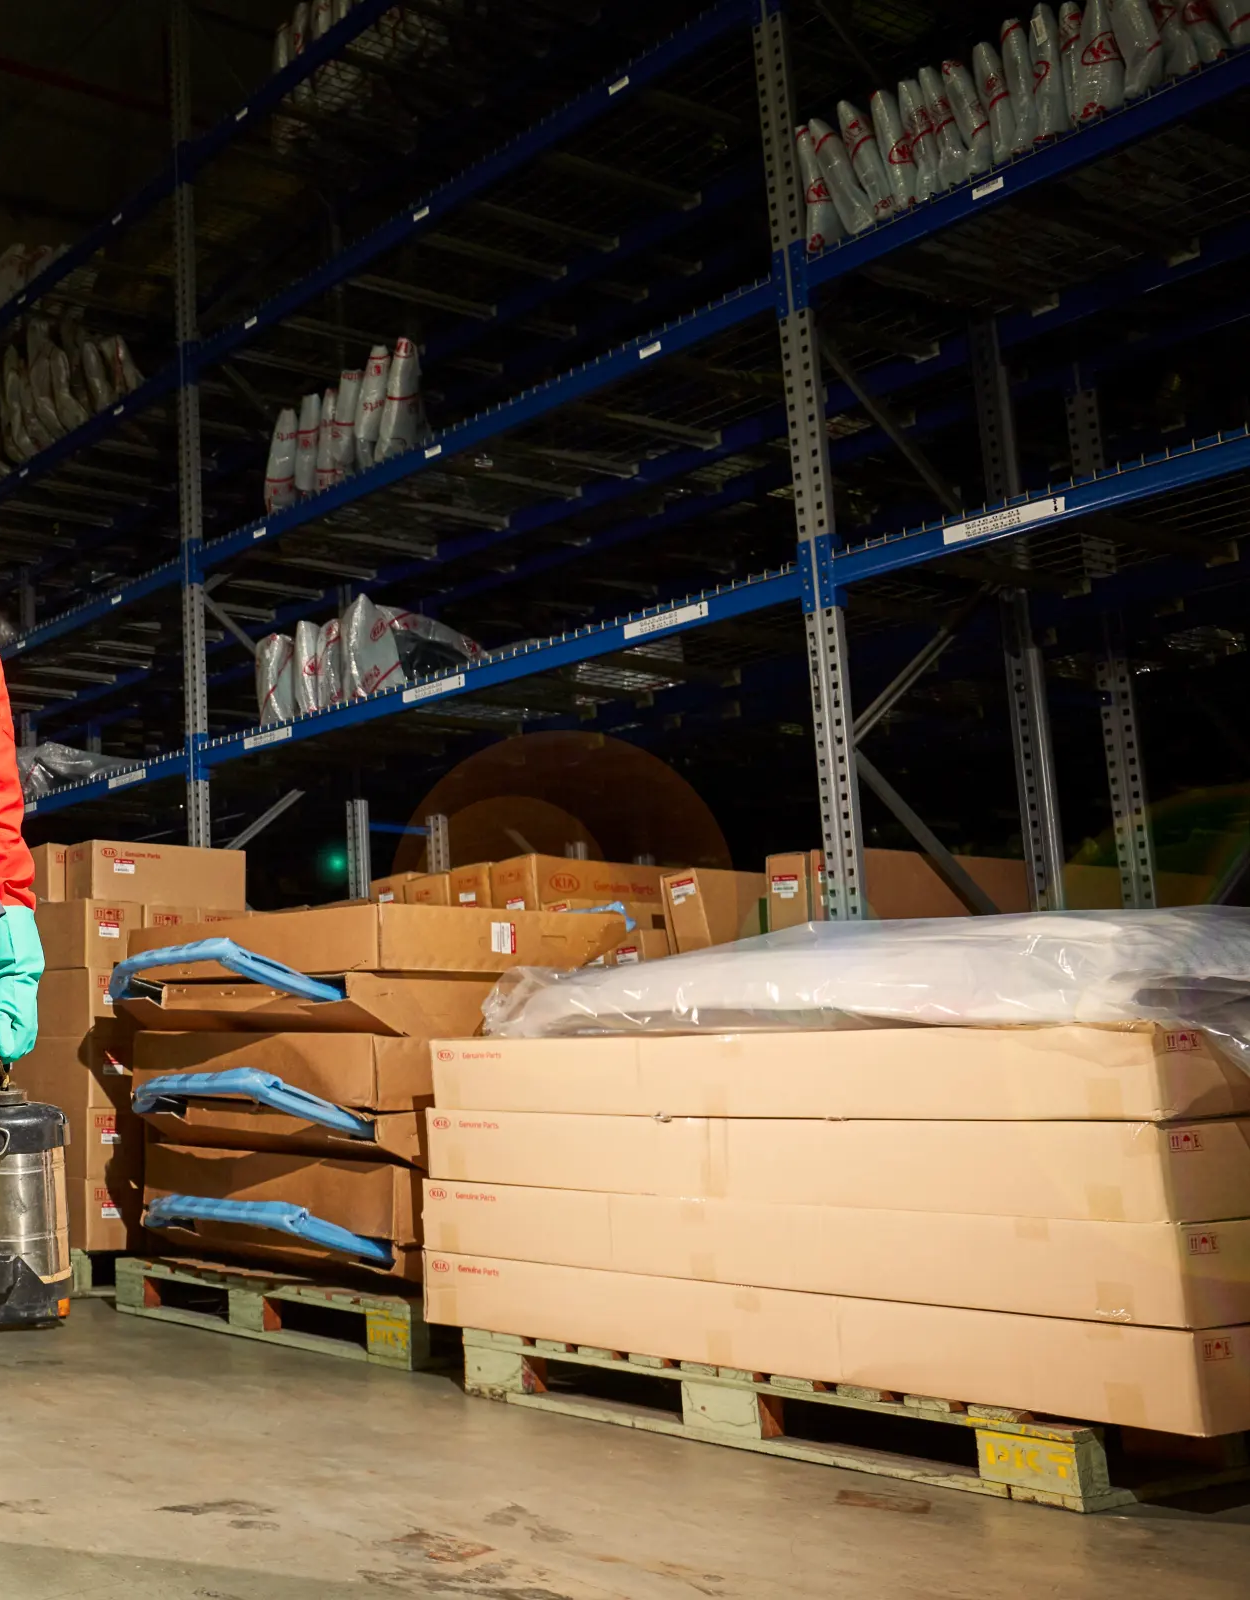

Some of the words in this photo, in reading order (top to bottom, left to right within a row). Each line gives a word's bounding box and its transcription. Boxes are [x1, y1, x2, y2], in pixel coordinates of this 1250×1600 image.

[103, 849, 116, 857] KIA
[552, 875, 577, 890] KIA
[438, 1051, 452, 1060] KIA
[486, 1051, 501, 1060] Parts
[434, 1118, 449, 1128] KIA
[483, 1121, 499, 1129] Parts
[430, 1189, 446, 1198] KIA
[480, 1193, 496, 1202] Parts
[433, 1261, 448, 1271] KIA
[483, 1267, 500, 1277] Parts
